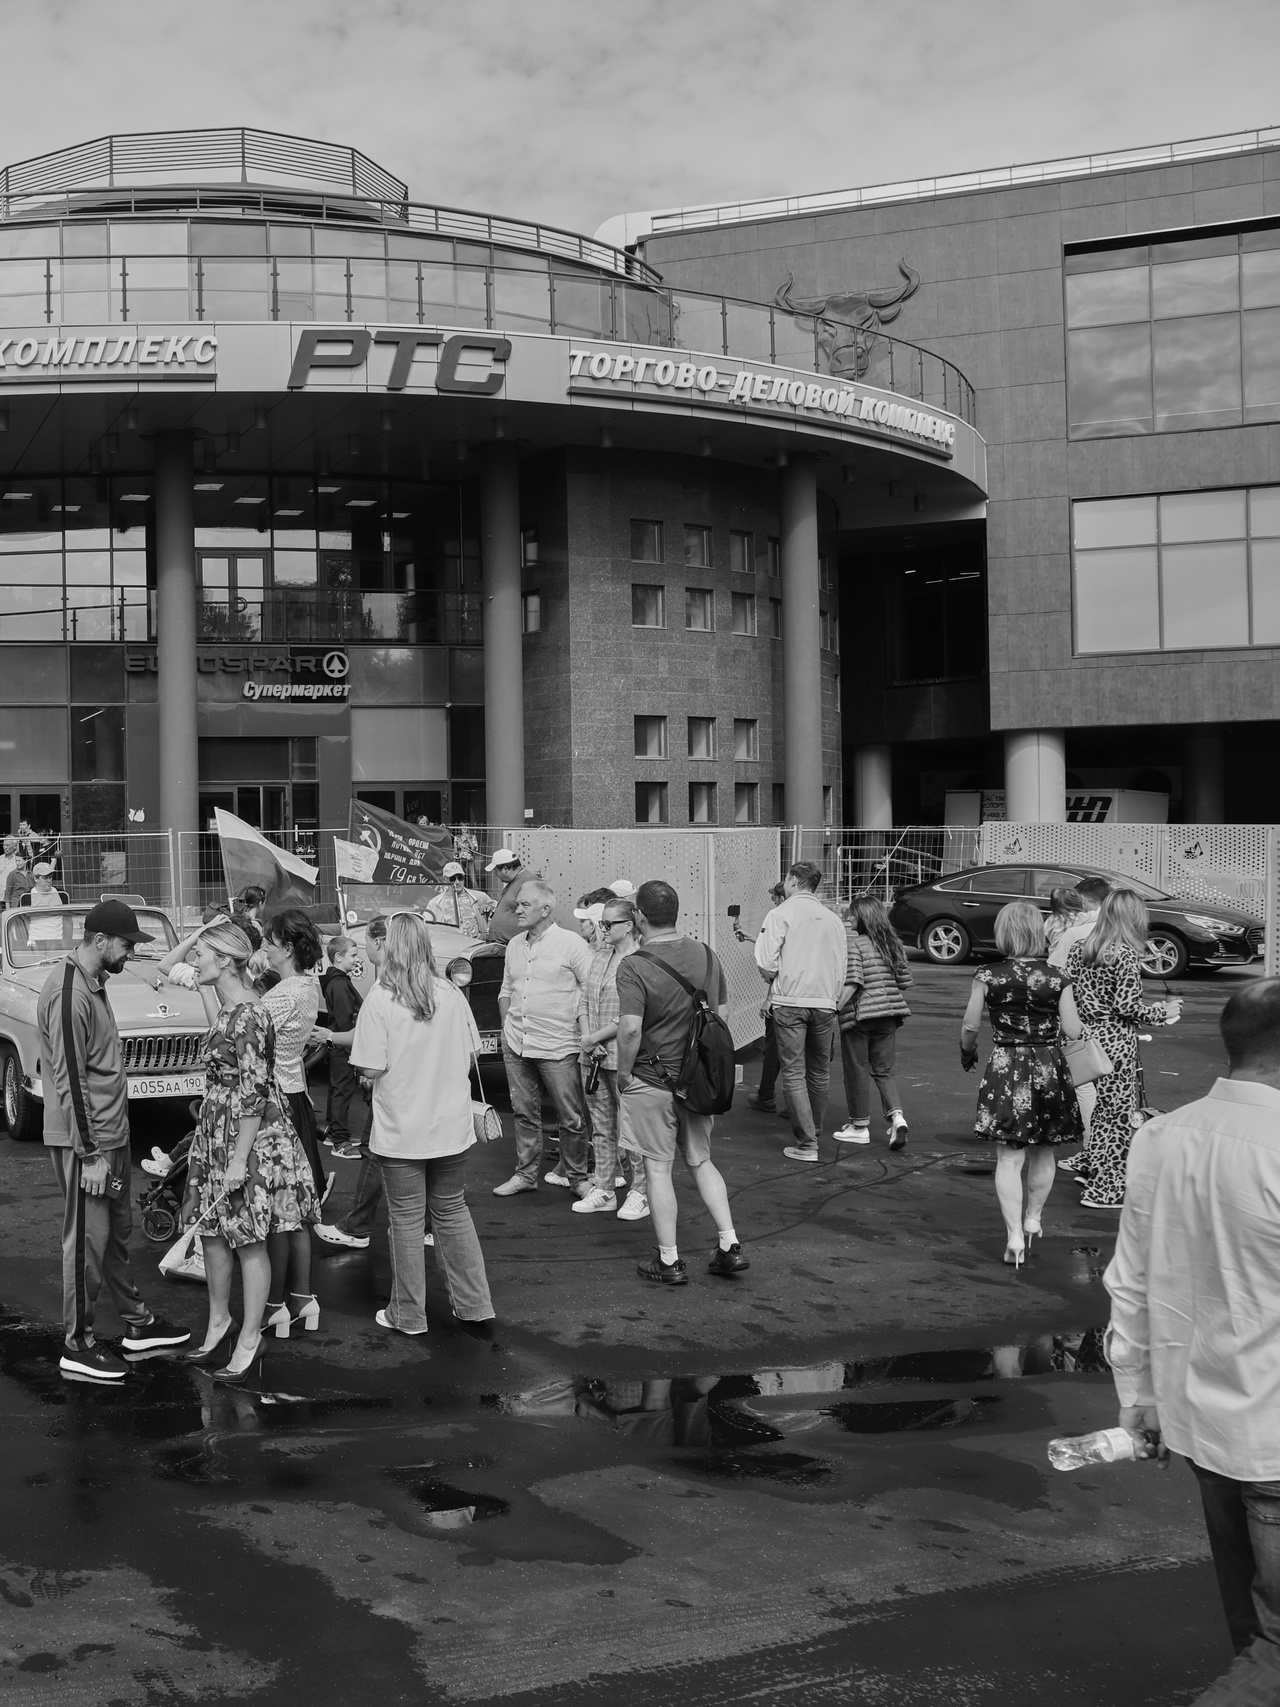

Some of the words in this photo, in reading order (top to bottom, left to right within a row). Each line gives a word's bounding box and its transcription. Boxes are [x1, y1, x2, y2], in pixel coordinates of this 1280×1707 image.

[569, 349, 856, 416] ТОРГОВО-ДЕЛОВОЙ
[859, 395, 956, 446] КОМПЛЕКС
[242, 680, 352, 700] Супермаркет
[389, 864, 407, 882] 79
[481, 1039, 495, 1049] 174
[183, 1077, 201, 1088] 190
